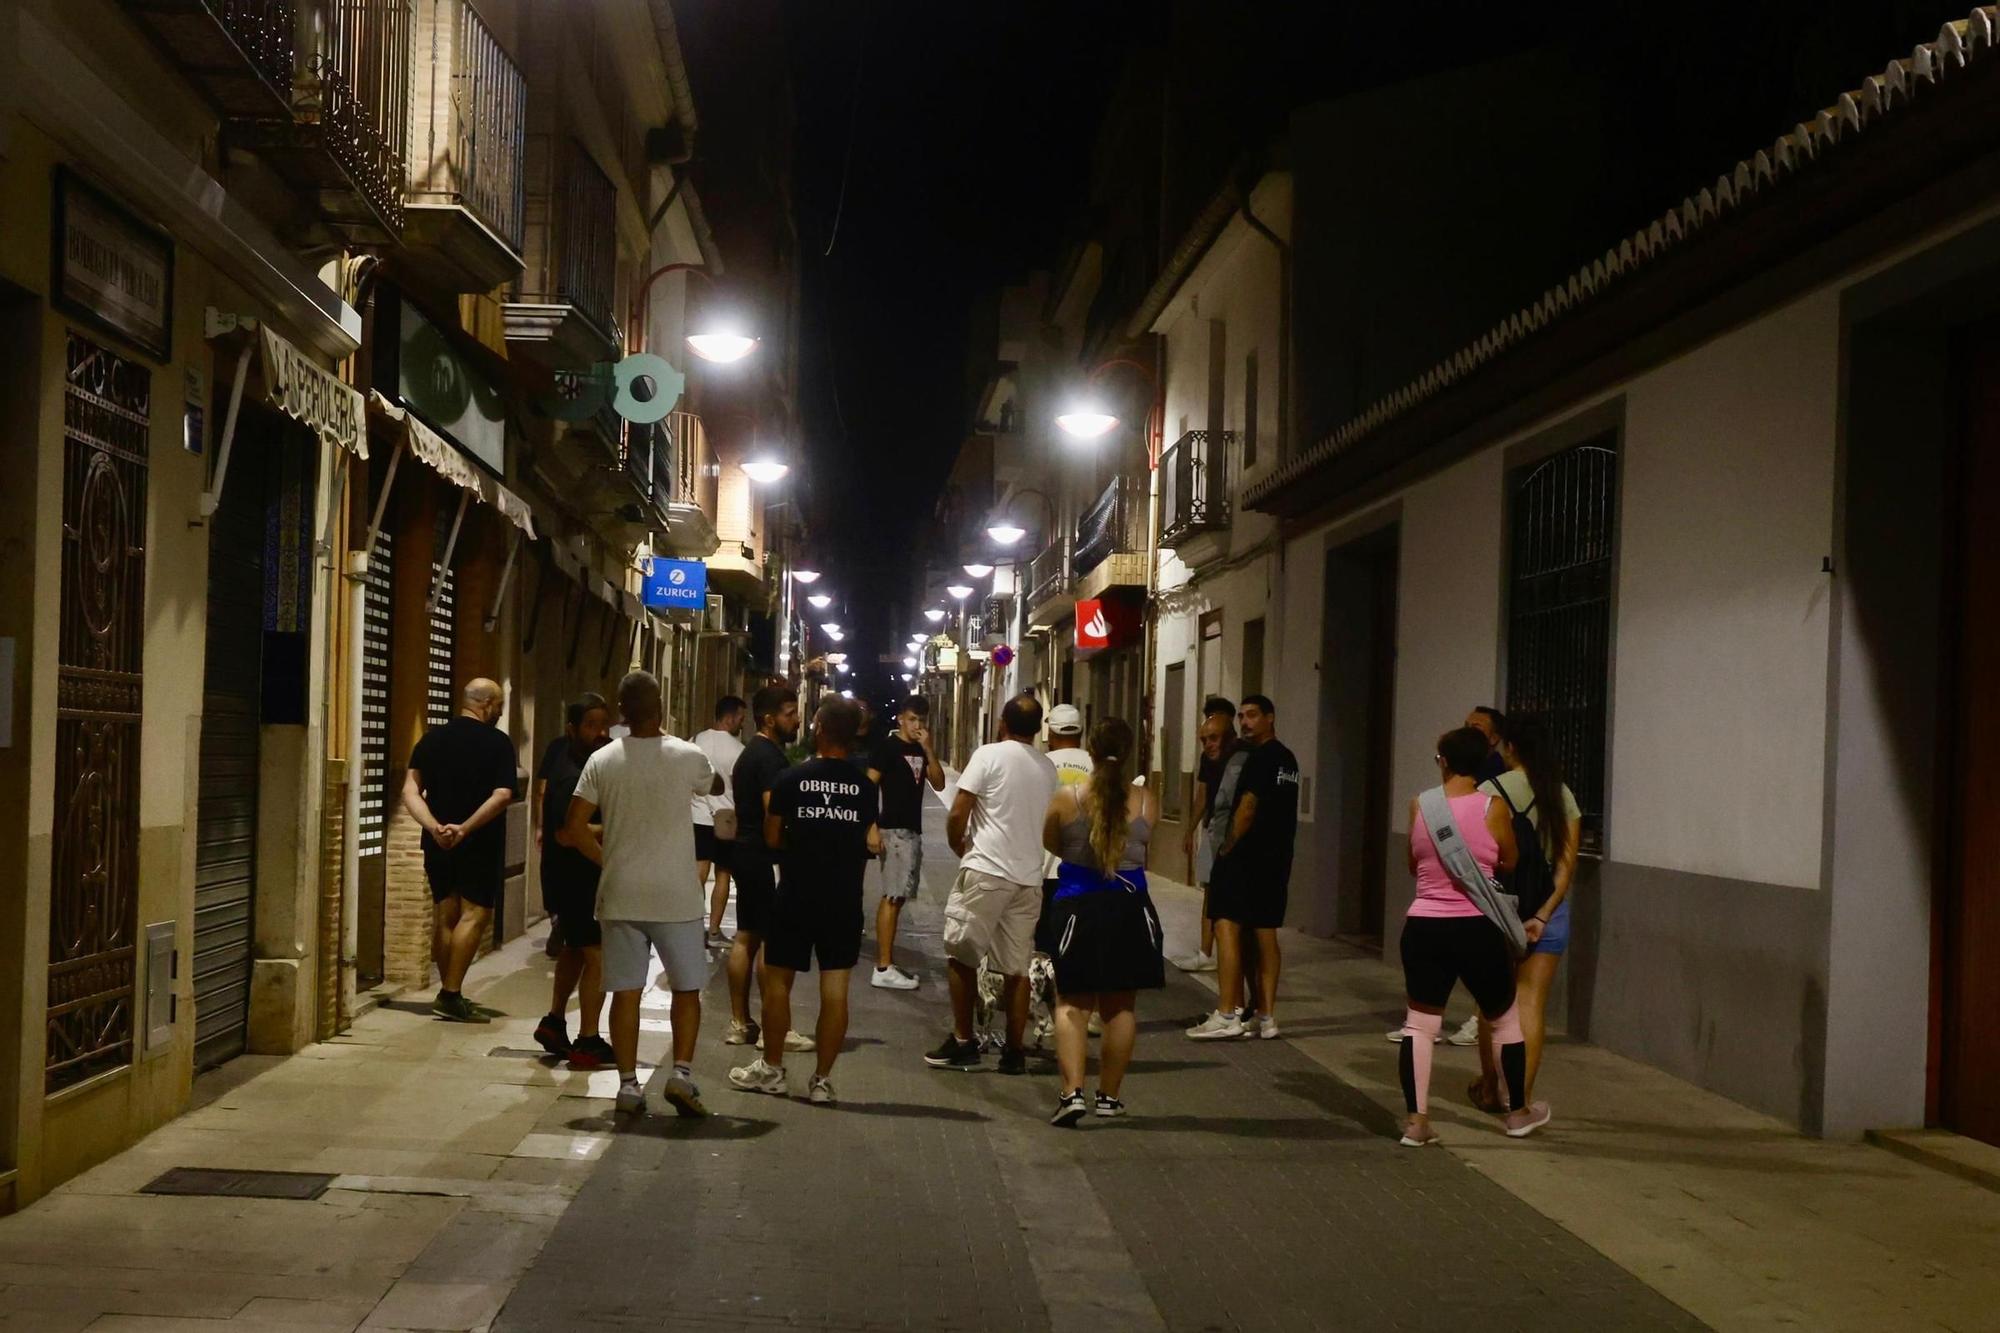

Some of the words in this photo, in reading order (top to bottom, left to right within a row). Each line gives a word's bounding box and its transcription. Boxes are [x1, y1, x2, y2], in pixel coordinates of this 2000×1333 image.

[656, 586, 697, 599] ZURICH
[799, 779, 860, 796] OBRERO
[822, 793, 832, 805] Y
[797, 805, 860, 823] ESPAÑOL
